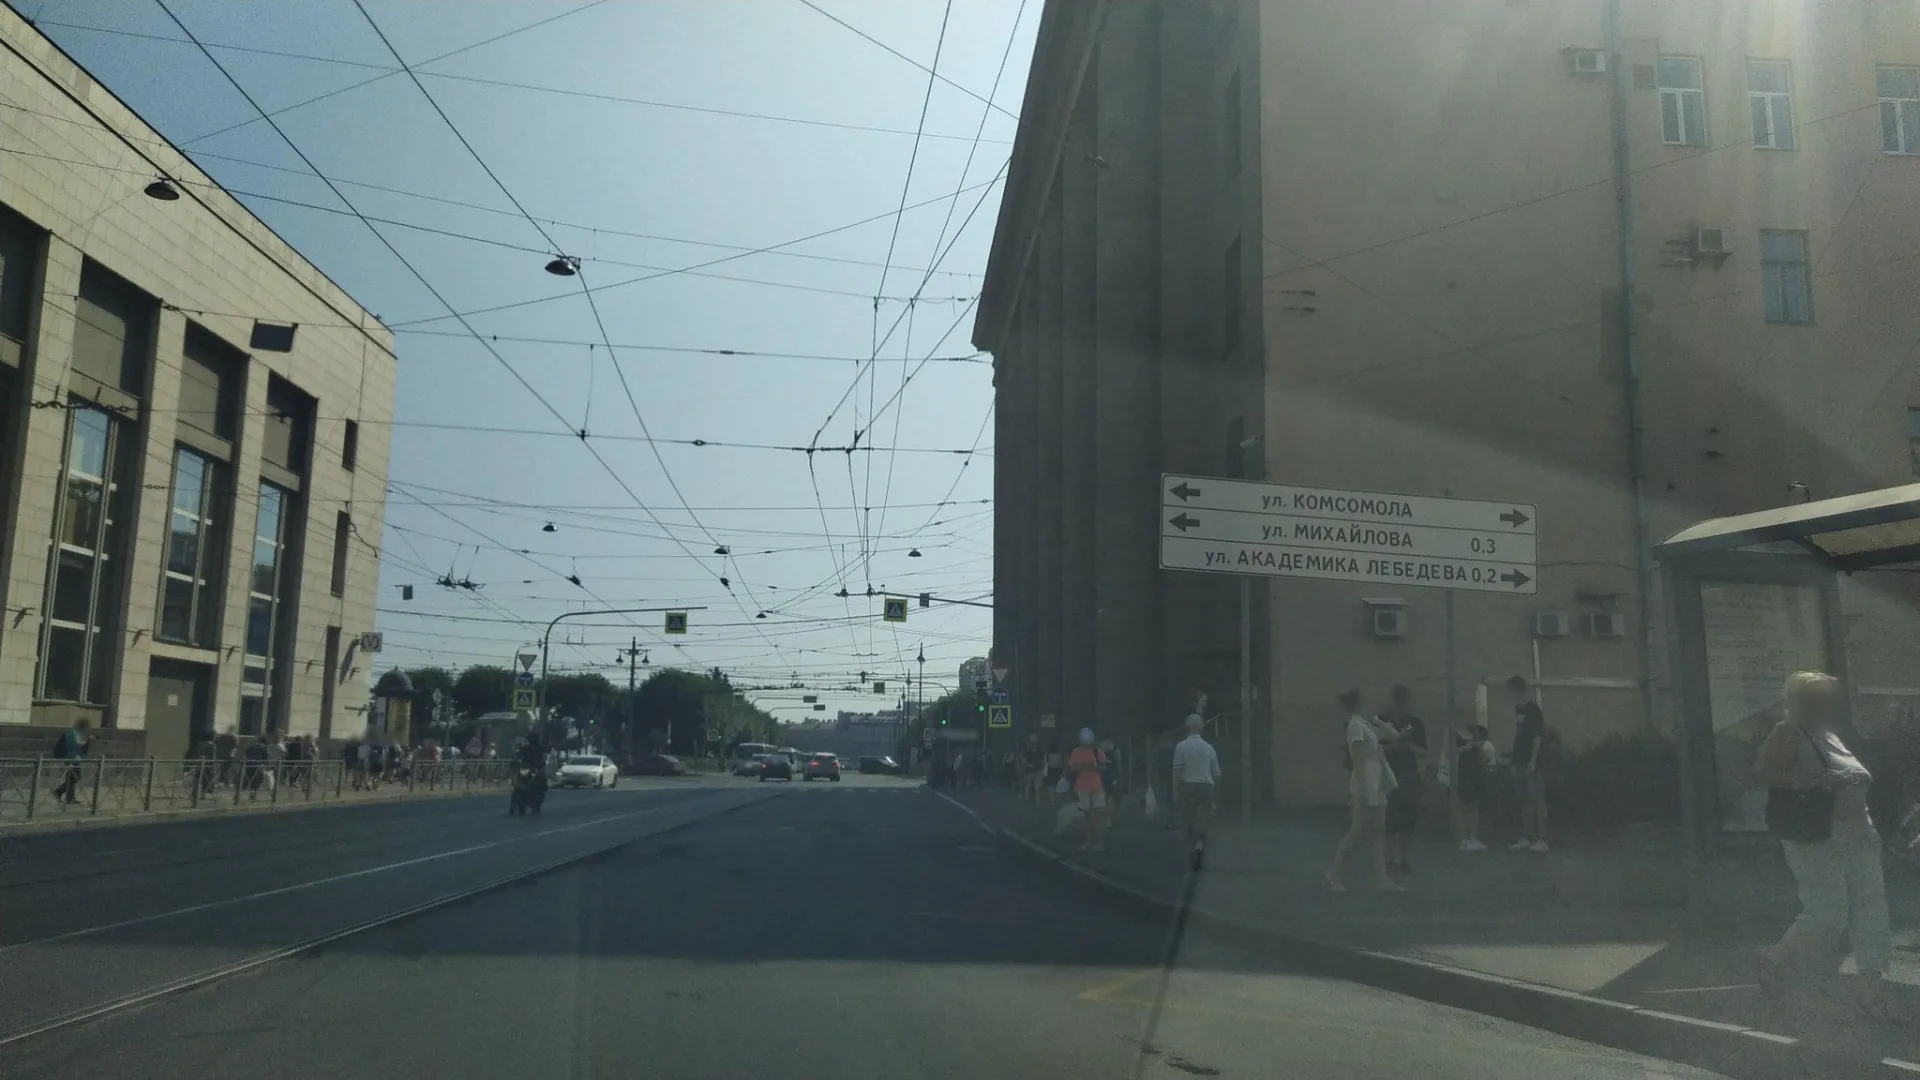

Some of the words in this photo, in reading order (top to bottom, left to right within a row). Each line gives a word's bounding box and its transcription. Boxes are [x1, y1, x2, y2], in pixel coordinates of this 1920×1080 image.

[1262, 494, 1287, 510] ул.
[1293, 494, 1413, 518] КОМСОМОЛА
[1262, 525, 1287, 540] ул.
[1294, 523, 1413, 548] МИХАЙЛОВА
[1205, 551, 1231, 566] ул.
[1237, 549, 1359, 574] АКАДЕМИКА
[1366, 559, 1467, 581] ЛЕБЕДЕВА
